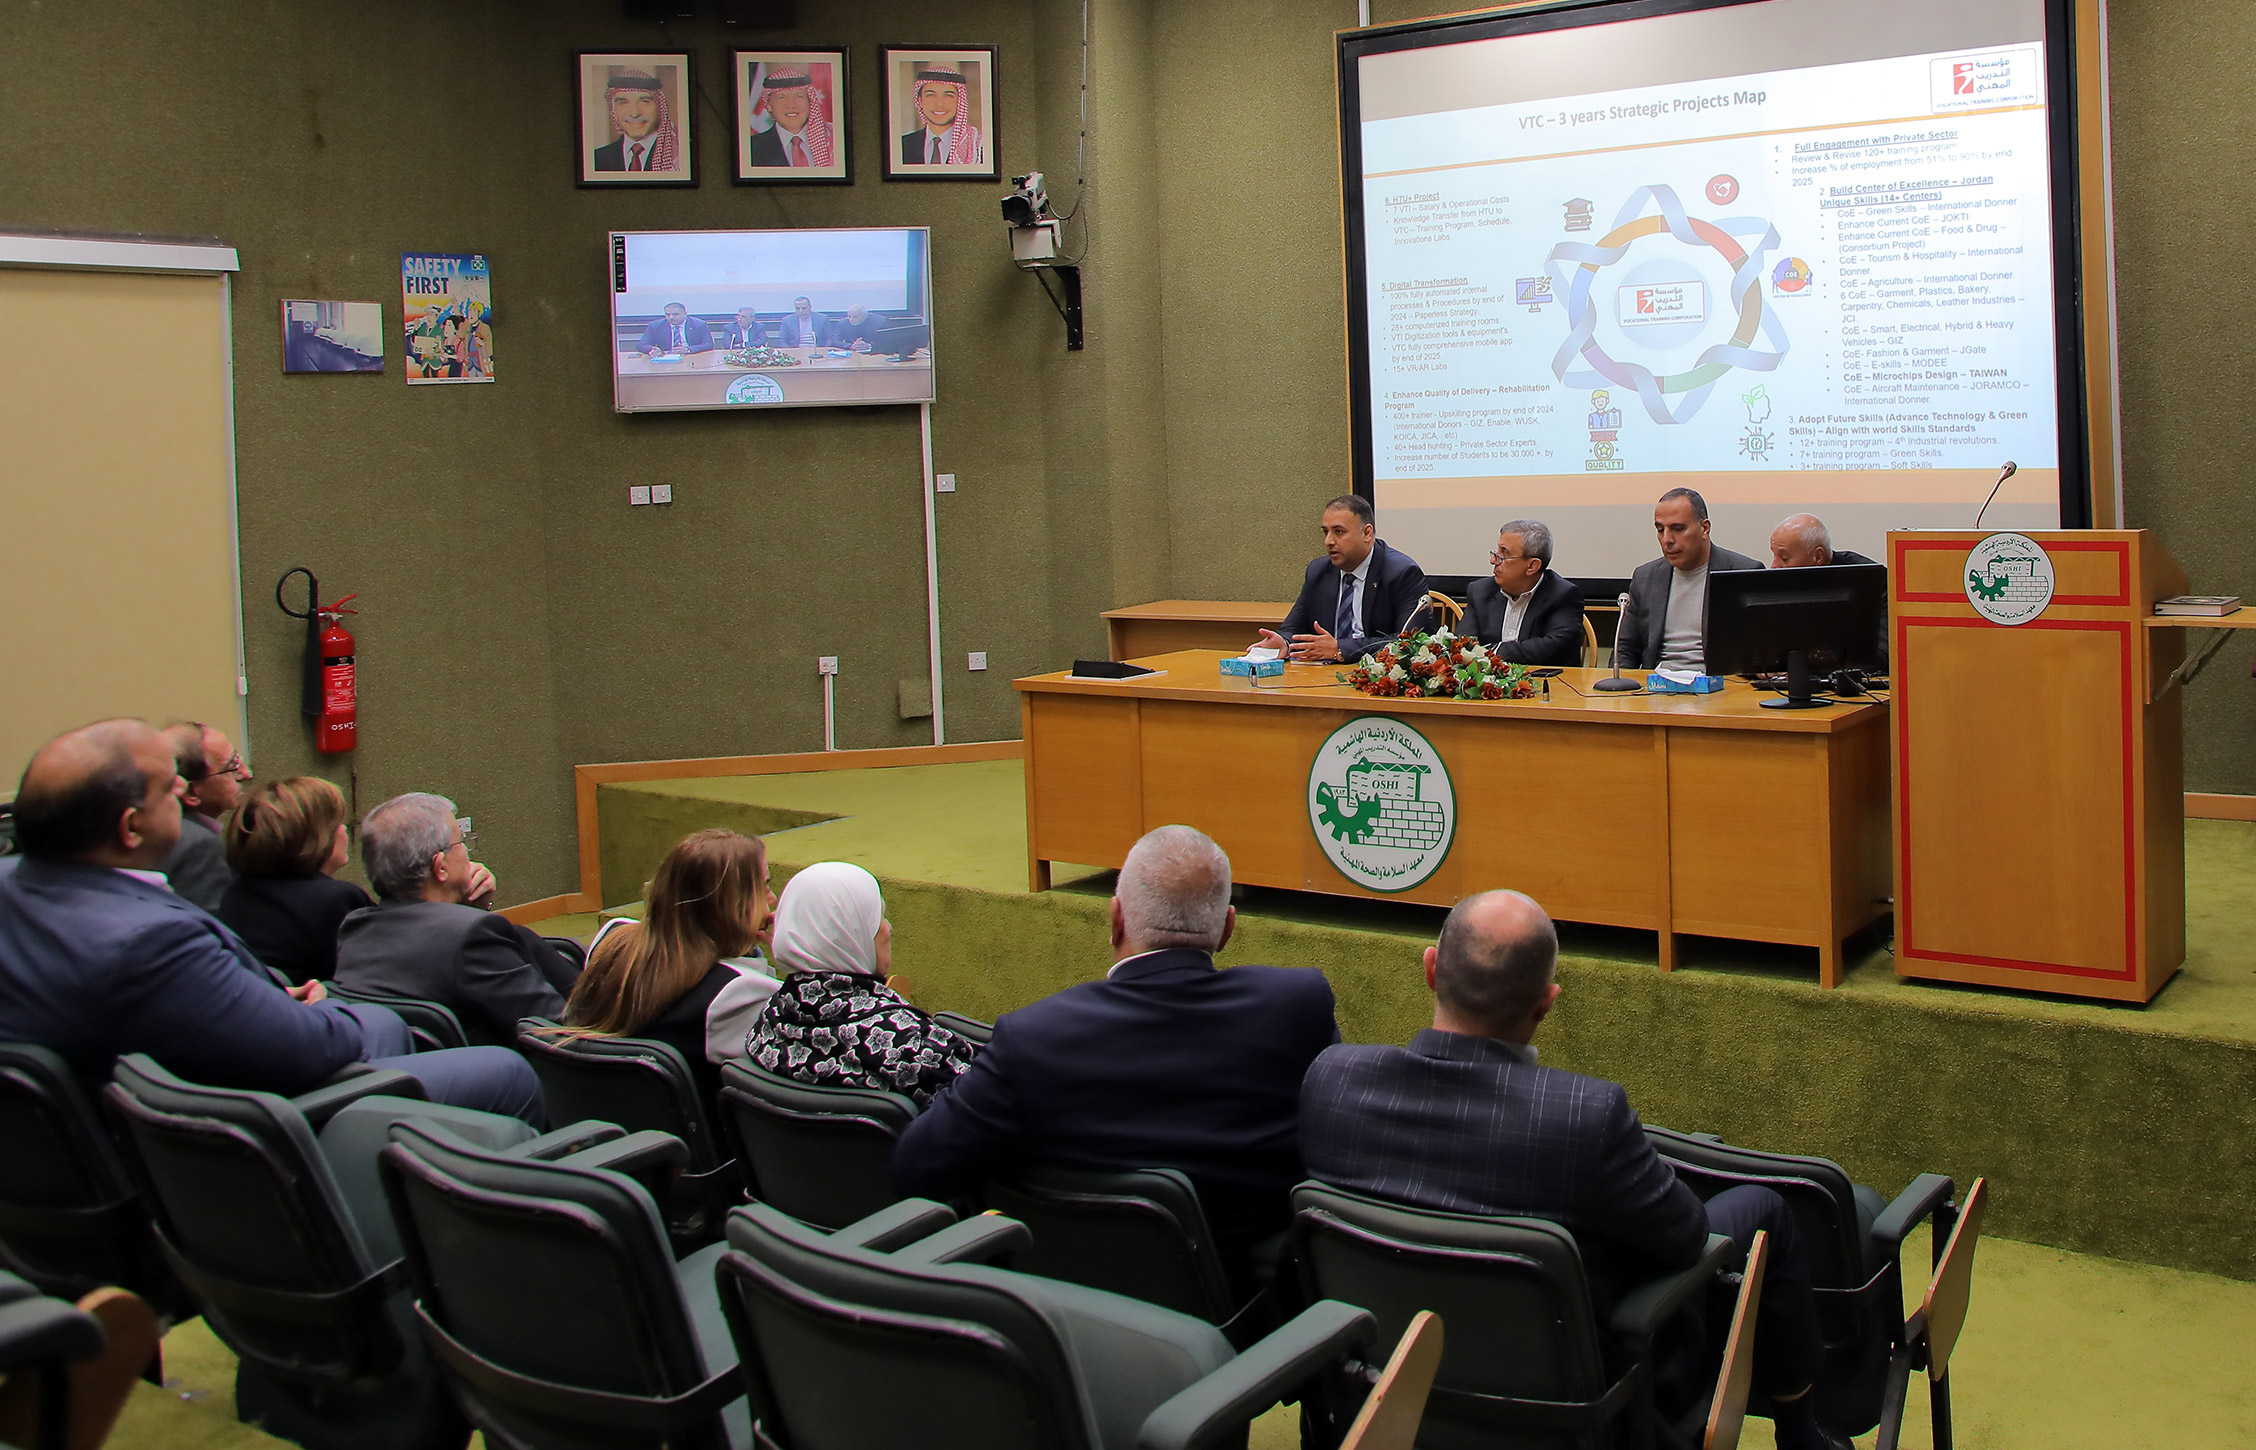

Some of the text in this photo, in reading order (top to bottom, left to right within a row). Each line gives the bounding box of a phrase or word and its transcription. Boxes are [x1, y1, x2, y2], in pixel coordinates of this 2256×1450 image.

[1976, 58, 2010, 68] مؤسسة
[1976, 68, 2010, 80] التدريب
[1976, 79, 2010, 94] المهني
[1519, 91, 1767, 130] VTC 3 years Strategic Projects Map
[1795, 129, 1958, 151] Full Engagement with Private Sector
[1792, 153, 1822, 164] Review
[1832, 150, 1861, 160] Revise
[1792, 157, 1923, 175] Increase employment from
[1829, 175, 1993, 195] Build Center Excellence Jordan
[1413, 191, 1440, 202] Project
[1820, 191, 1942, 208] Unique Skills Centers)
[1865, 200, 1982, 216] Green Skills International
[1838, 212, 1969, 230] Enhance Current JOKTI
[1838, 224, 1998, 242] Enhance Current Food Drug
[1839, 239, 1926, 255] (Consortium Project)
[1867, 246, 2024, 263] Tourism Hospitality International
[405, 257, 461, 276] SAFETY
[406, 276, 449, 294] FIRST
[1388, 276, 1468, 291] Digital Transformation
[1867, 273, 1978, 289] Agriculture International
[1654, 294, 1683, 304] التدريب
[1935, 298, 1969, 308] Leather
[1971, 296, 2016, 306] Industries
[1655, 303, 1683, 314] المهني
[1944, 321, 1974, 333] Hybrid
[1985, 321, 2014, 331] Heavy
[1842, 337, 1877, 347] Vehicles
[1866, 345, 1987, 358] Fashion Garment JGate
[1871, 358, 1948, 369] E-skills MODEE
[1843, 368, 2008, 382] CoE Microchips Design TAIWAN
[1392, 383, 1550, 399] Enhance Quality Delivery Rehabilitation
[1871, 380, 2021, 393] Aircraft Maintenance JORAMCO
[1384, 401, 1415, 412] Program
[1844, 396, 1896, 406] International
[1798, 411, 2028, 425] Adopt Future Skills (Advance Technology Green
[1788, 424, 1976, 437] Skills) Align with world Skills Standards
[1817, 436, 1947, 449] training program industrial
[1812, 449, 1917, 460] training program Green
[1890, 460, 1908, 469] Soft
[1910, 460, 1933, 469] Skills
[1336, 730, 1366, 754] الهاشمية
[1399, 733, 1422, 759] المملكة
[1372, 780, 1399, 790] OSHI
[1340, 846, 1424, 880] معهد السلامة والصحة المهنية
